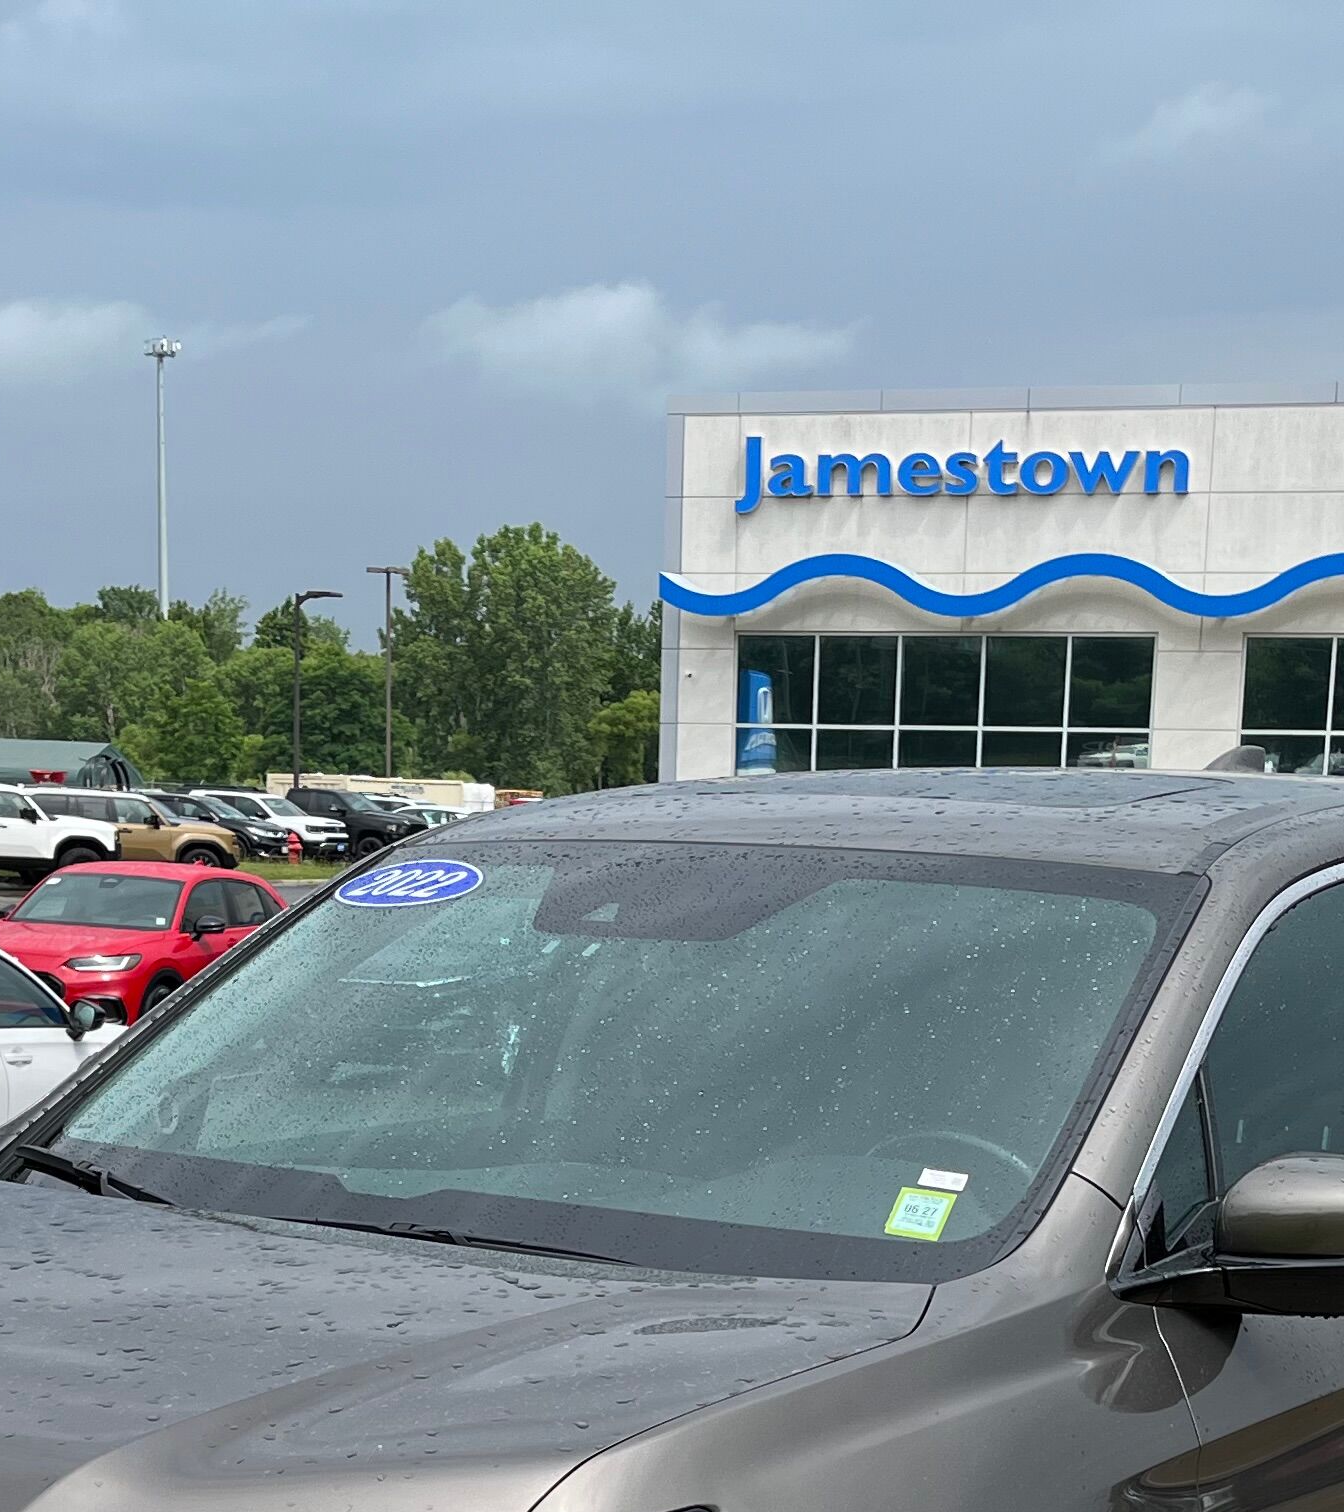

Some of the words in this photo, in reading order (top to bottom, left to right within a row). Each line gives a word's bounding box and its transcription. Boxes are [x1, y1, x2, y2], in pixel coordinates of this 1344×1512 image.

[734, 435, 1190, 515] Jamestown
[345, 869, 468, 898] 2022
[921, 1205, 938, 1217] 27
